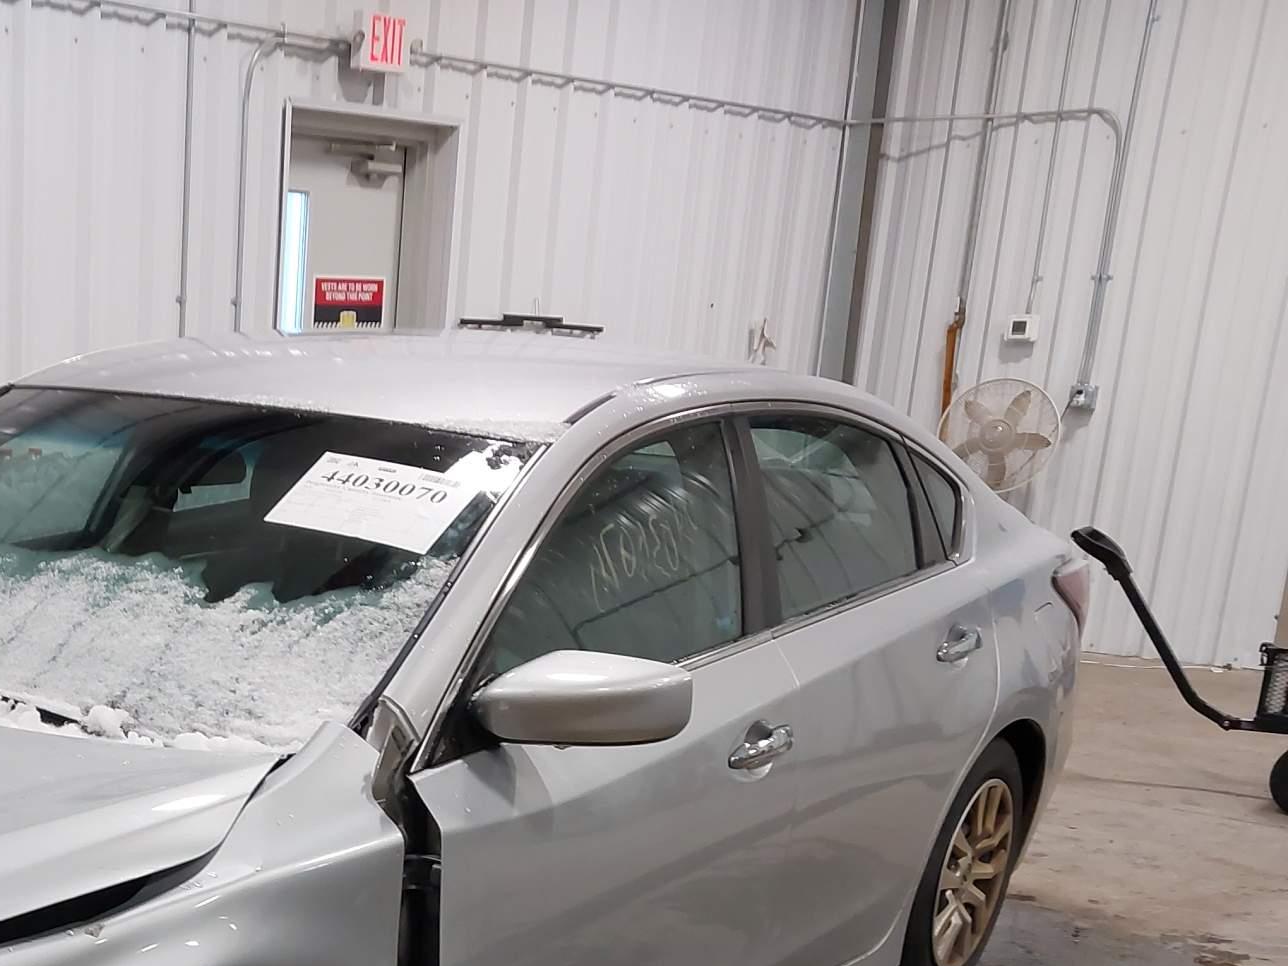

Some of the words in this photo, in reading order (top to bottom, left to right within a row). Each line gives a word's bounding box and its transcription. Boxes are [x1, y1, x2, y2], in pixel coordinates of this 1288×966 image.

[370, 15, 406, 66] EXIT
[321, 282, 337, 291] VESTS
[338, 282, 348, 291] ARE
[320, 470, 448, 504] 44030070
